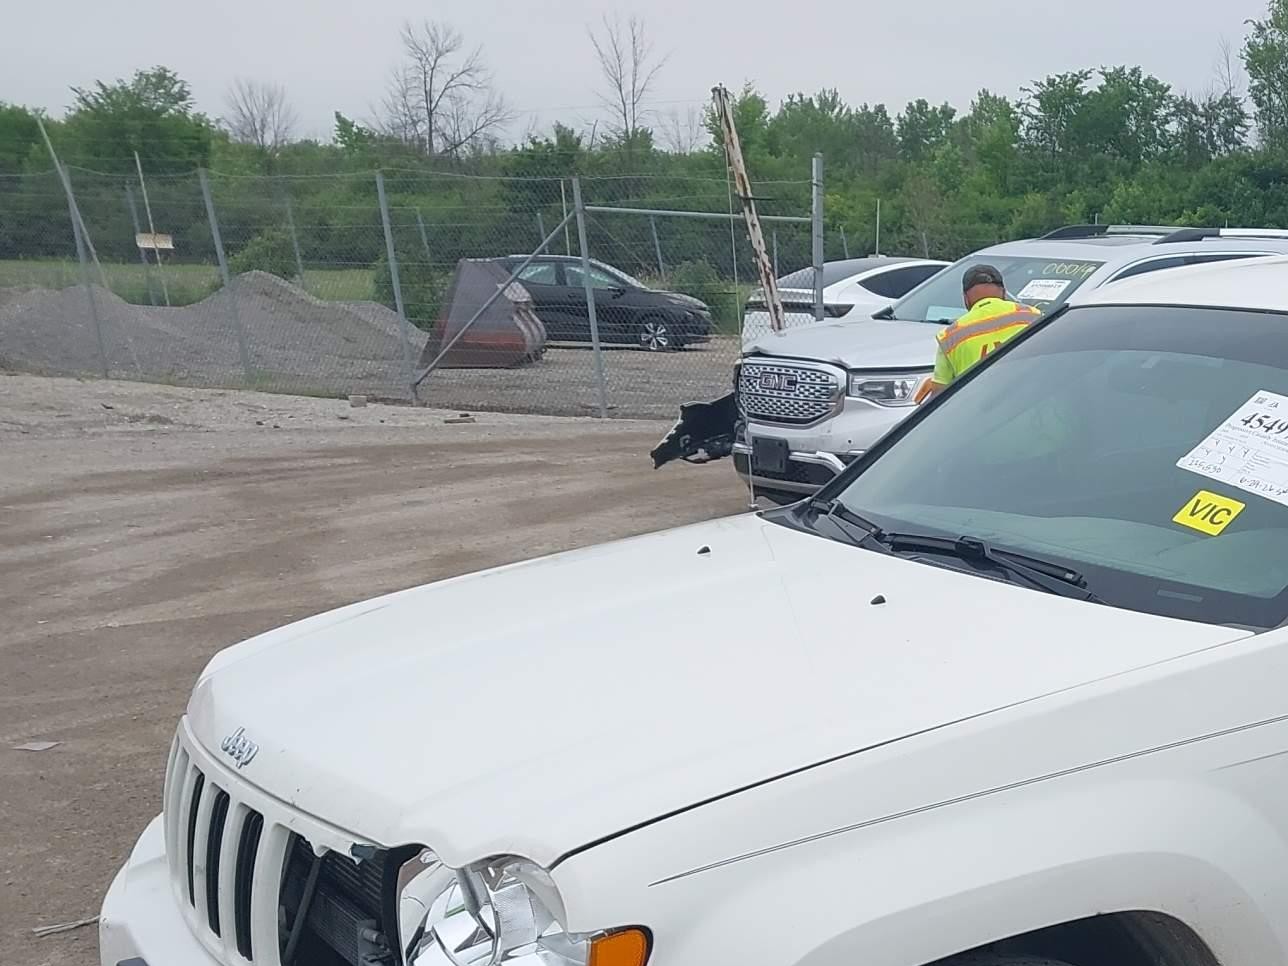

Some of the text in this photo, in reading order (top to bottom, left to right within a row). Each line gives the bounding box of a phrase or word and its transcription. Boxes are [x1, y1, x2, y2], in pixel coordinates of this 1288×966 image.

[761, 373, 797, 391] GMC
[1188, 499, 1232, 526] VIC
[221, 726, 260, 770] Jeep
